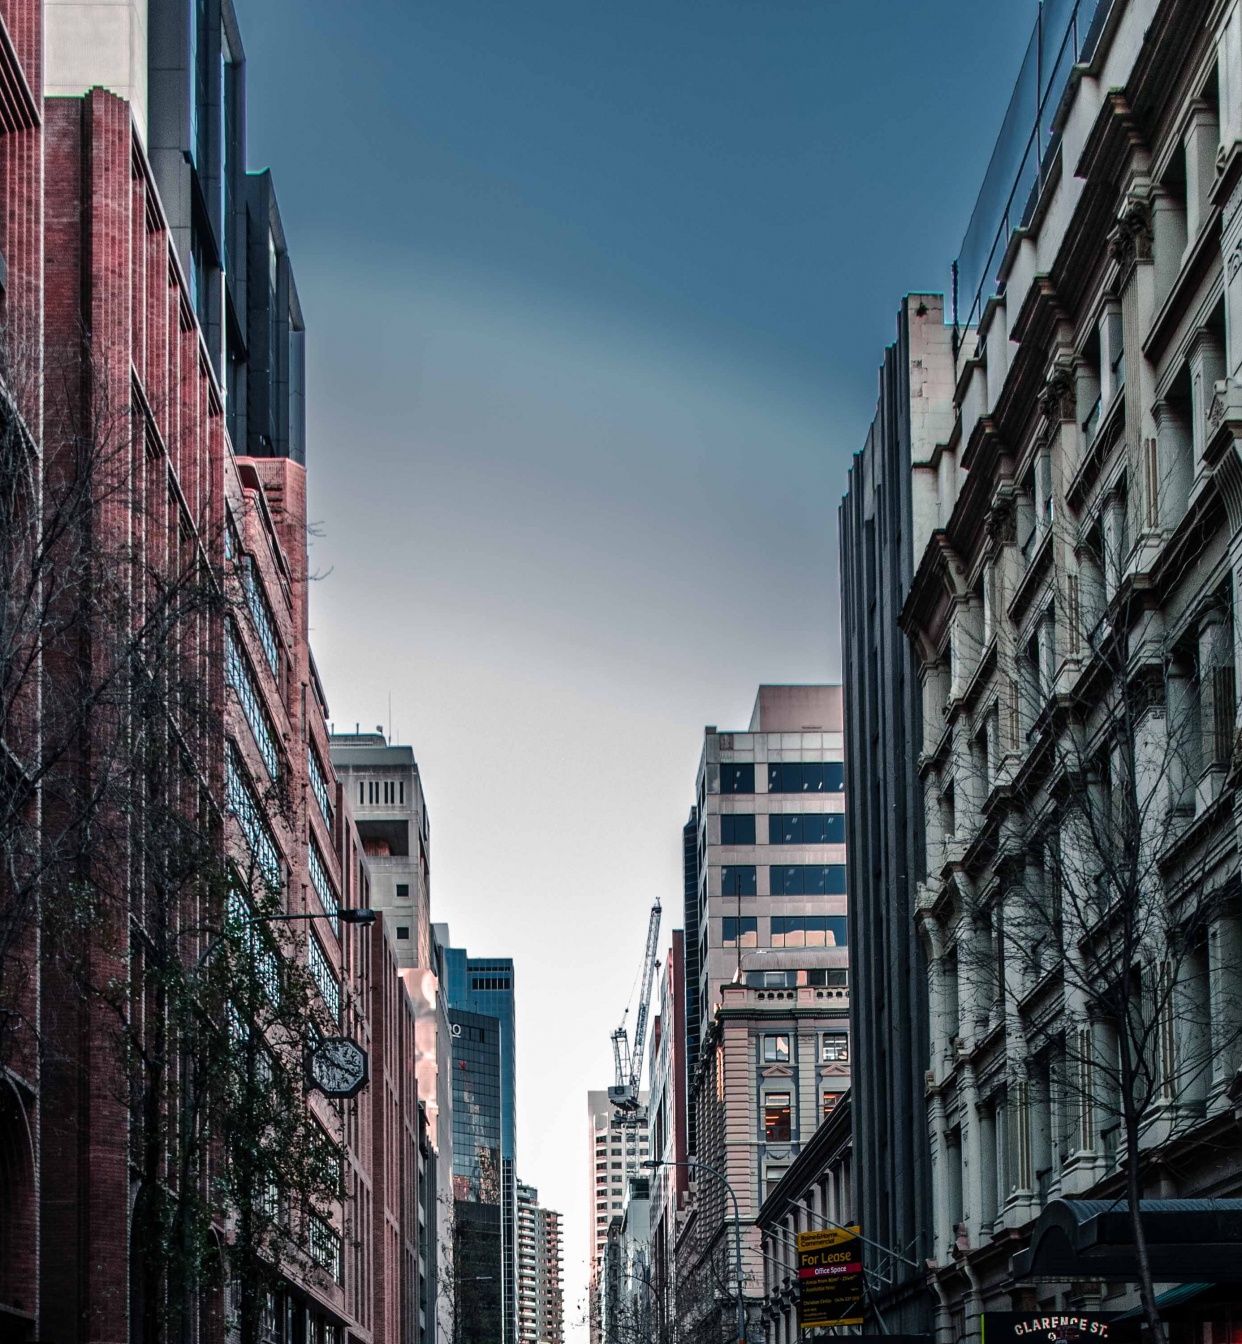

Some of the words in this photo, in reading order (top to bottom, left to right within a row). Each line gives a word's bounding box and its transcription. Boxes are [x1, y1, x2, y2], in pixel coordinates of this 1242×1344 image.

[801, 1238, 834, 1247] Commercial
[801, 1254, 819, 1266] For
[821, 1251, 852, 1264] Lease
[814, 1267, 830, 1275] Office
[830, 1266, 847, 1275] Space
[1014, 1316, 1088, 1336] CLARENCE
[1090, 1321, 1109, 1338] ST.
